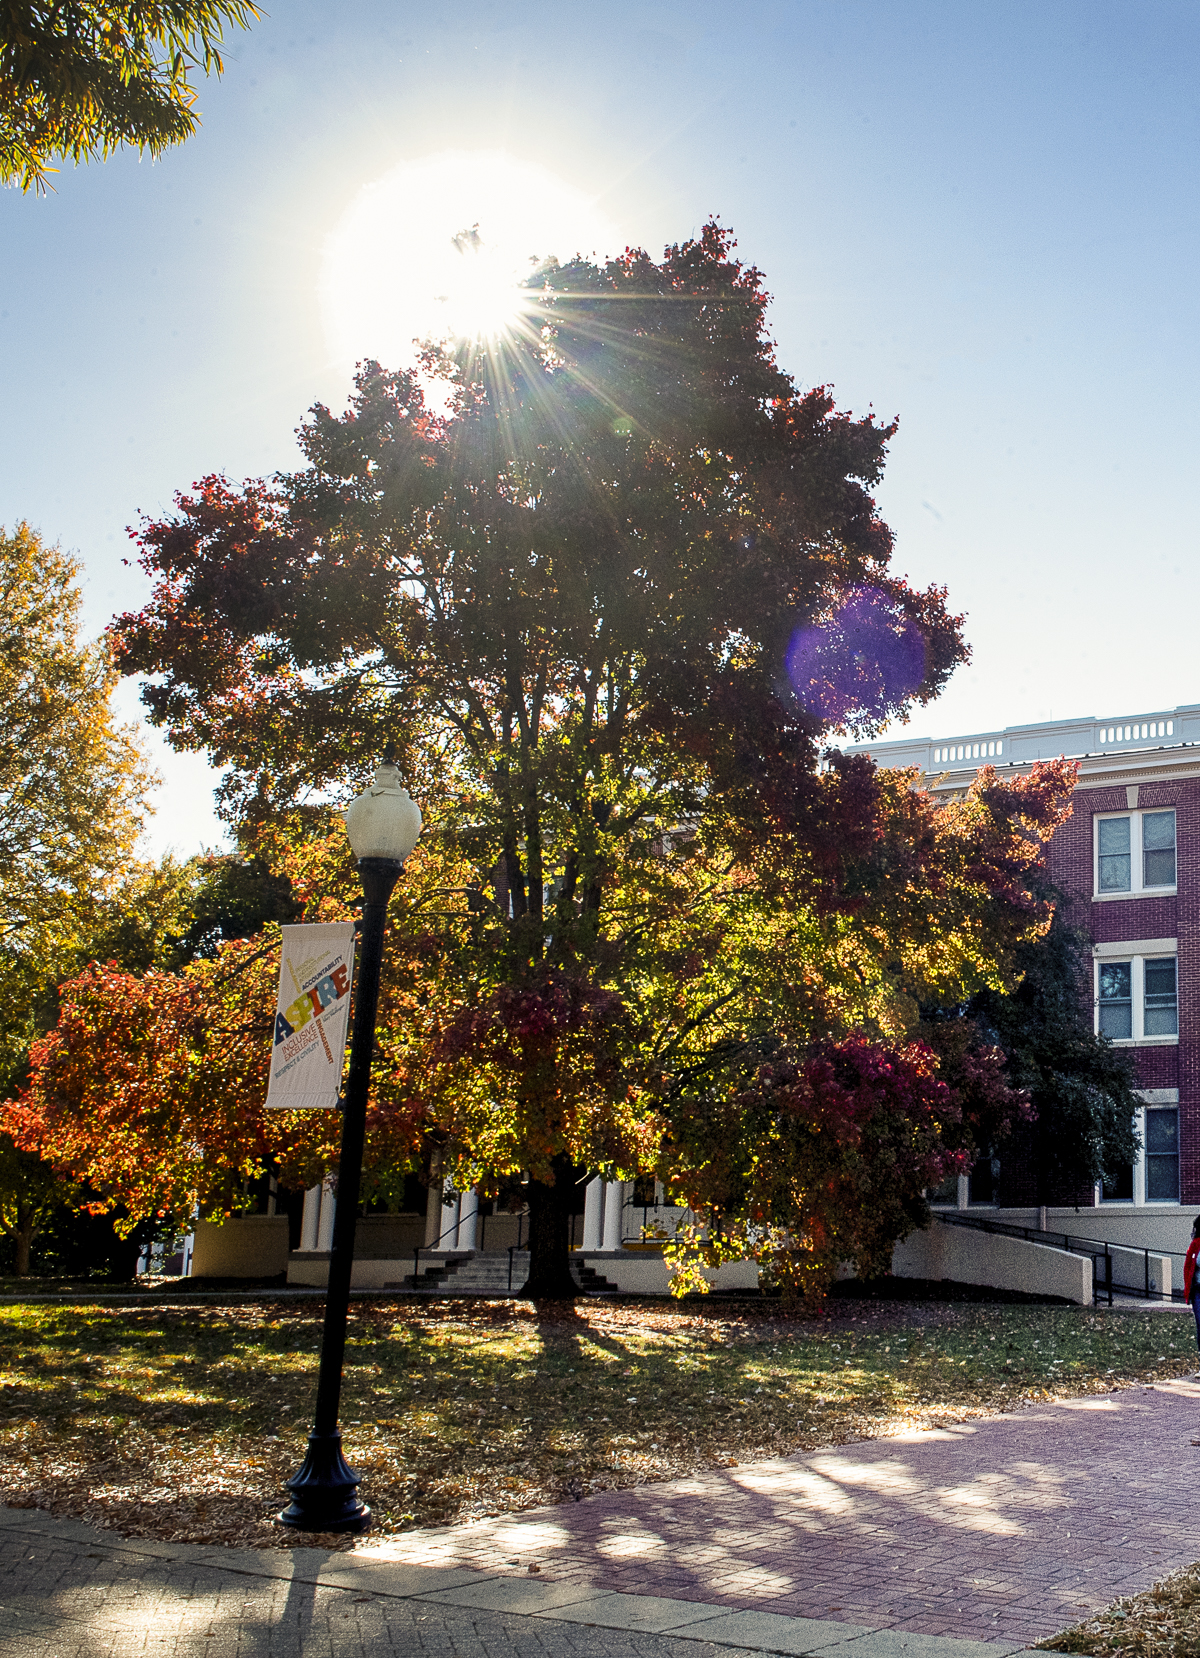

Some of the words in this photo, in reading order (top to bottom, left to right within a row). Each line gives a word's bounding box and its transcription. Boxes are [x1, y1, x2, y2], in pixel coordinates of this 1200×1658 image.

[302, 955, 343, 991] ACCOUNTABILITY
[275, 963, 350, 1046] ASPIRE
[282, 1022, 315, 1055] INCLUSIVE
[284, 1029, 318, 1062] EXCELLENCE
[316, 1018, 334, 1064] ENGAGEMENT
